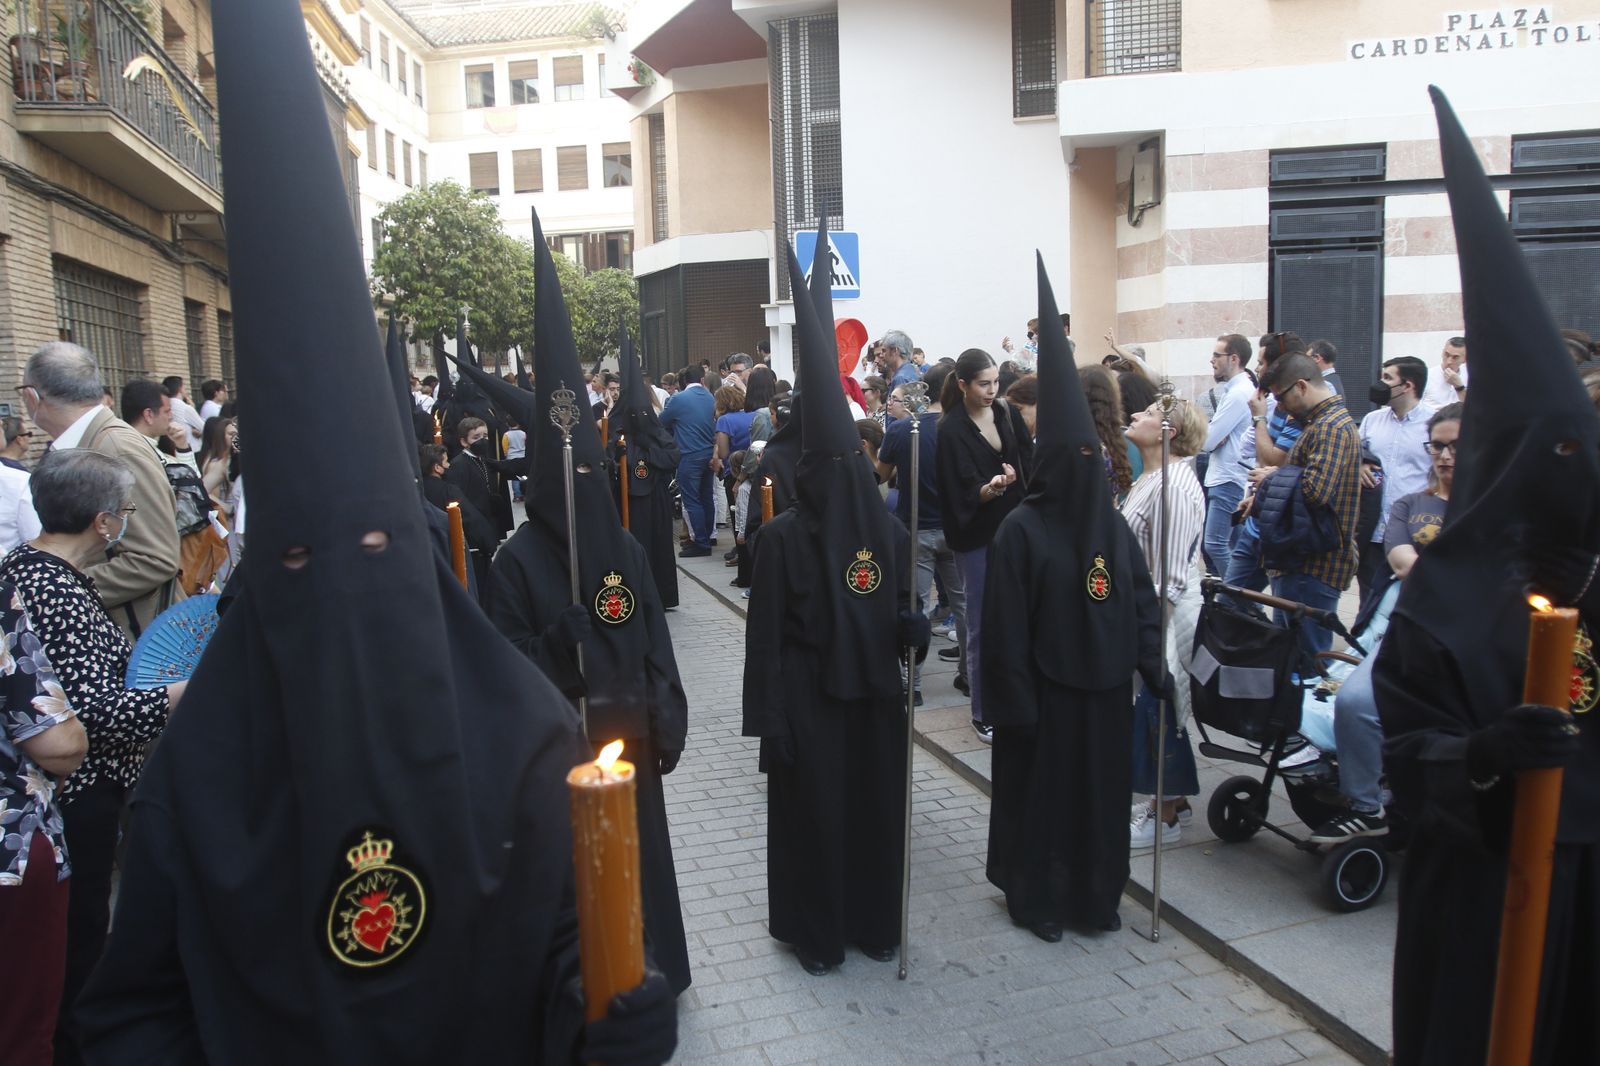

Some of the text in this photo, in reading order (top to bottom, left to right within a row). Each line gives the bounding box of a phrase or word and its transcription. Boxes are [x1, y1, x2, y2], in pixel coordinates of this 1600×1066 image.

[1447, 8, 1550, 31] PLAZA
[1351, 23, 1600, 59] CARDENAL TOL
